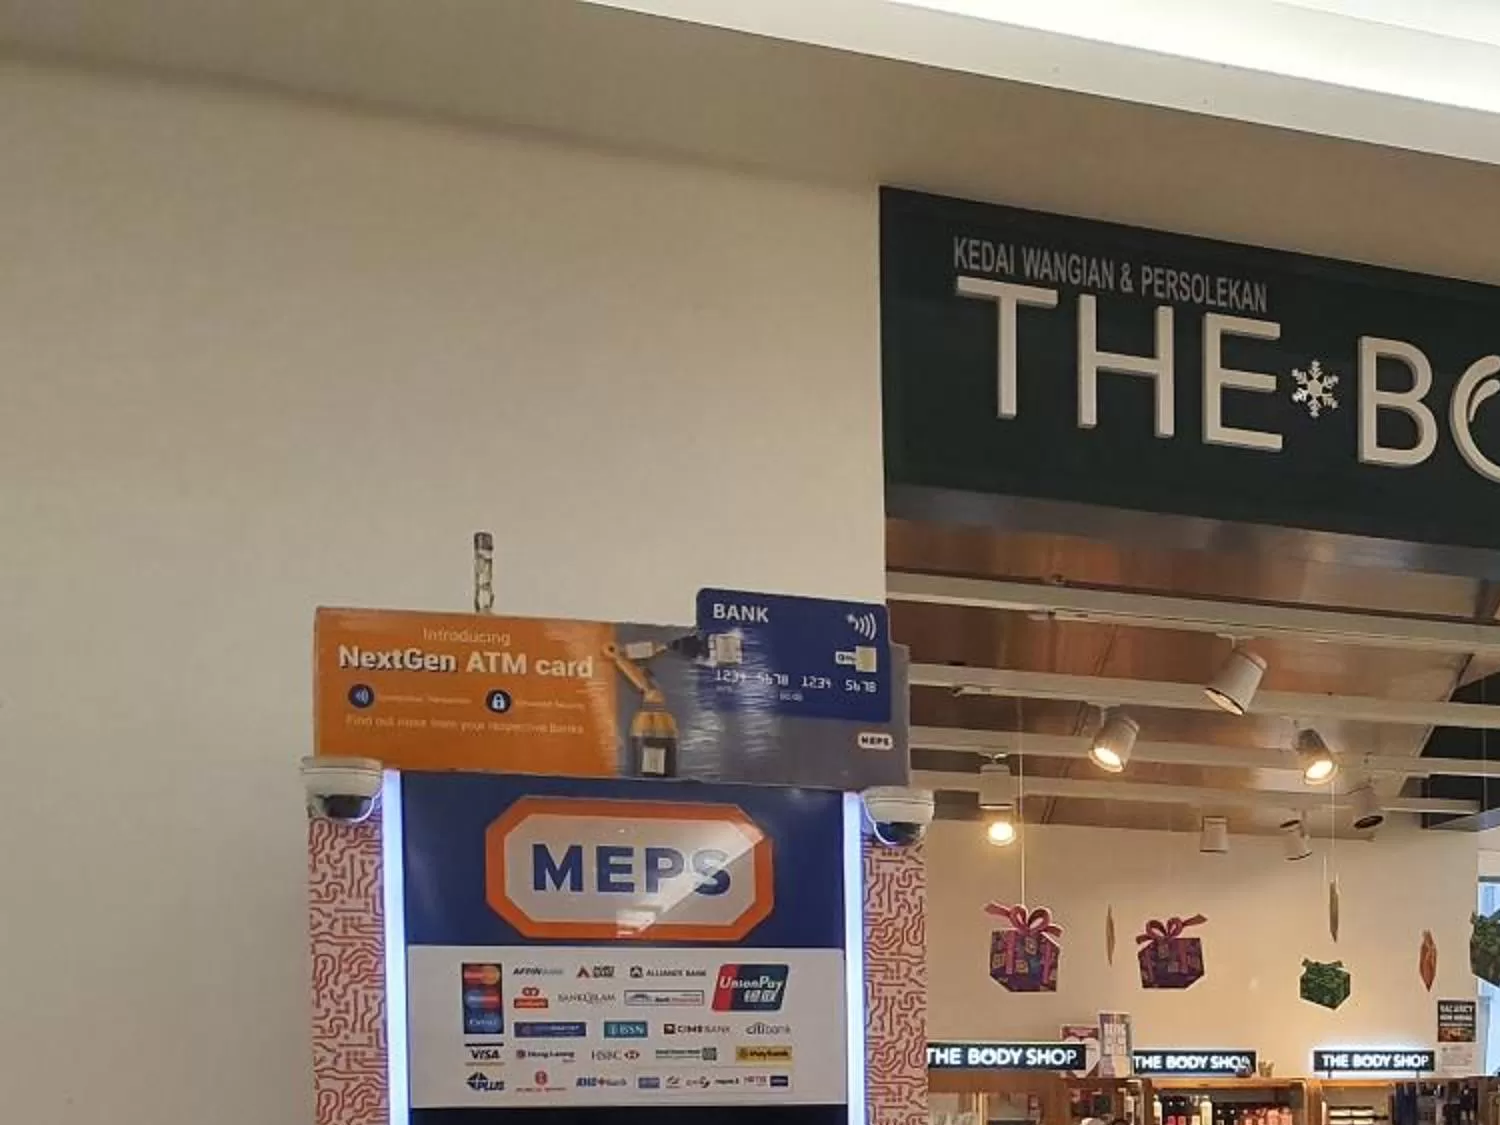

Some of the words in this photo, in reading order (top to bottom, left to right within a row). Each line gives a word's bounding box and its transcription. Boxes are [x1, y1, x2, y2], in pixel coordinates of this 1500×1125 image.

[953, 236, 1015, 275] KEDAI
[1022, 247, 1115, 291] WANGIAN
[1119, 267, 1134, 293] &
[1141, 263, 1268, 313] PERSOLEKAN
[955, 274, 1284, 453] THE
[712, 603, 769, 624] BANK
[423, 627, 511, 647] Introducing
[338, 644, 458, 673] NextGen
[465, 652, 527, 675] ATM
[535, 656, 593, 678] card
[801, 675, 832, 690] 1234
[844, 679, 877, 693] 5678
[531, 843, 733, 897] MEPS
[719, 976, 783, 993] UnionPay
[470, 1050, 501, 1061] VISA
[926, 1047, 962, 1066] THE
[966, 1047, 1022, 1066] BODY
[1025, 1047, 1078, 1066] SHOP
[1133, 1055, 1163, 1070] THE
[1166, 1055, 1208, 1070] BODY
[1321, 1054, 1350, 1068] THE
[1352, 1054, 1393, 1068] BODY
[1393, 1054, 1429, 1068] SHOP
